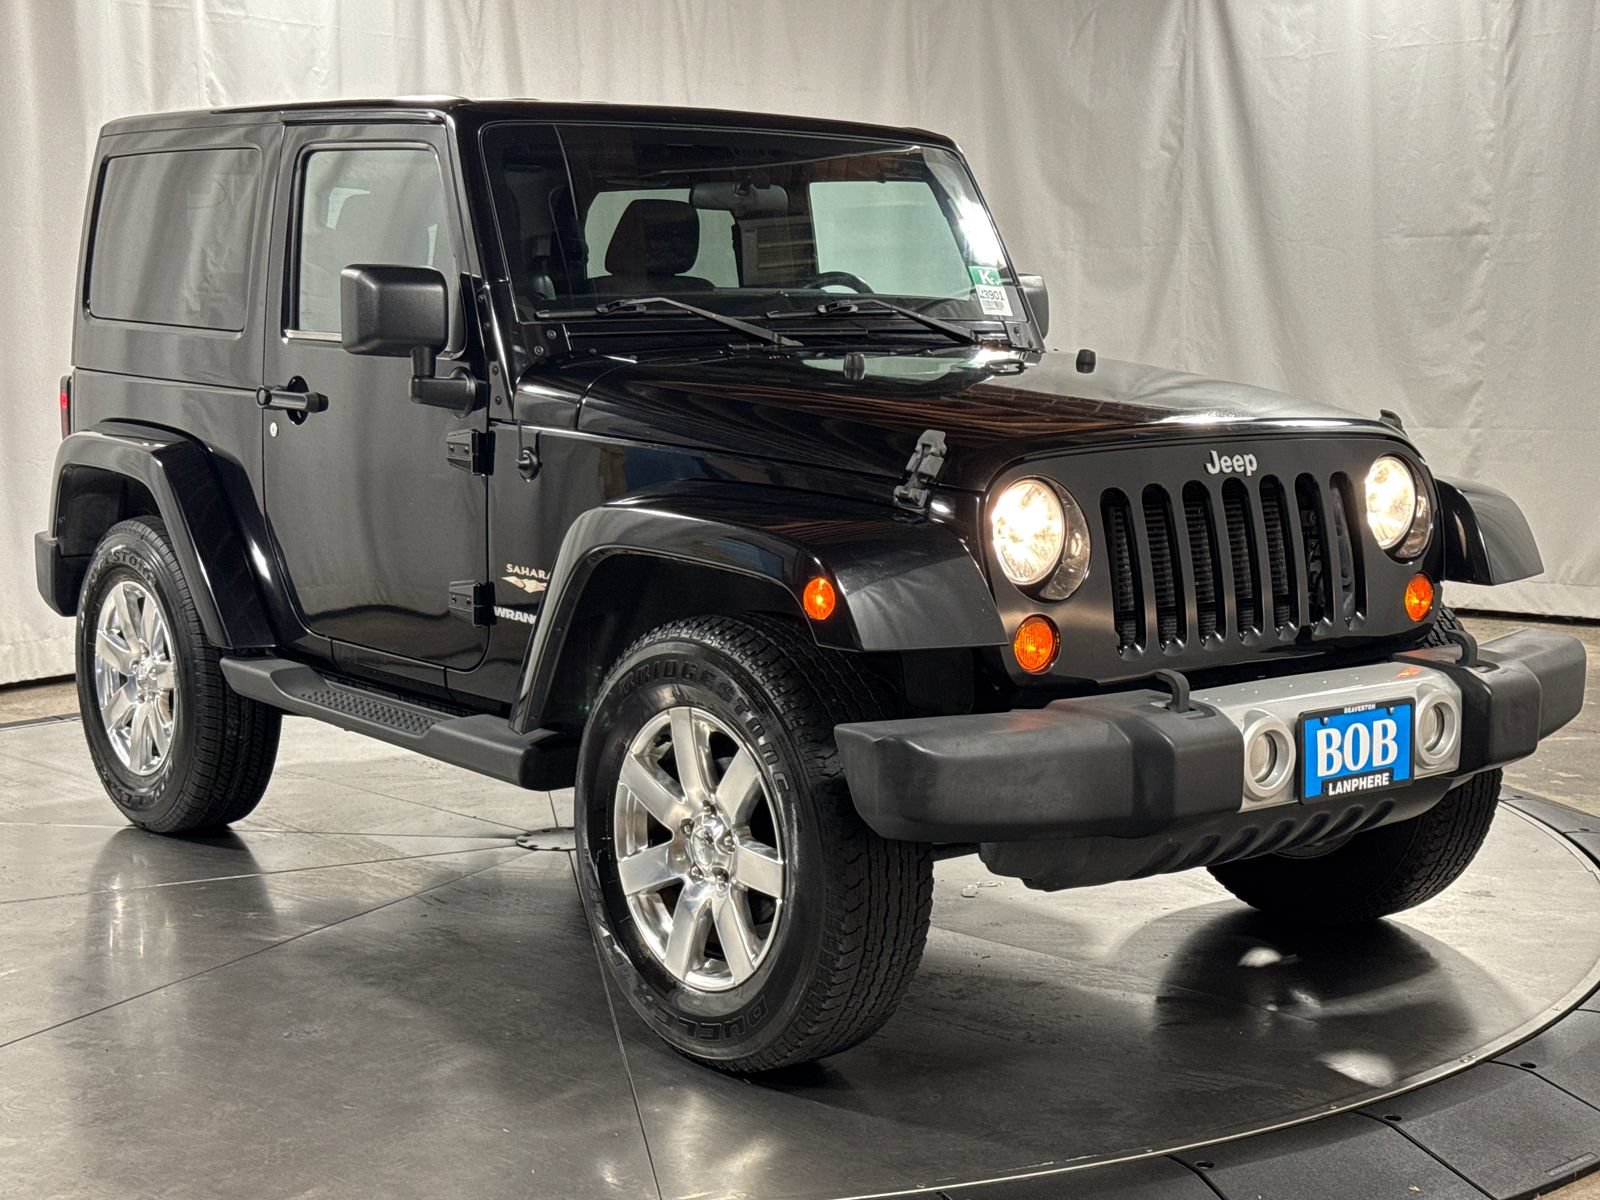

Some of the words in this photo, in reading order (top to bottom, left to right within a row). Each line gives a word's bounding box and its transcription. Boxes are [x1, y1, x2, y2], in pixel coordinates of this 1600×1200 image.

[1205, 449, 1258, 477] Jeep
[1344, 703, 1376, 714] BEAVERTON
[618, 658, 790, 793] BRIDGESTONE
[1316, 718, 1398, 777] BOB
[1328, 772, 1390, 796] LANPHERE
